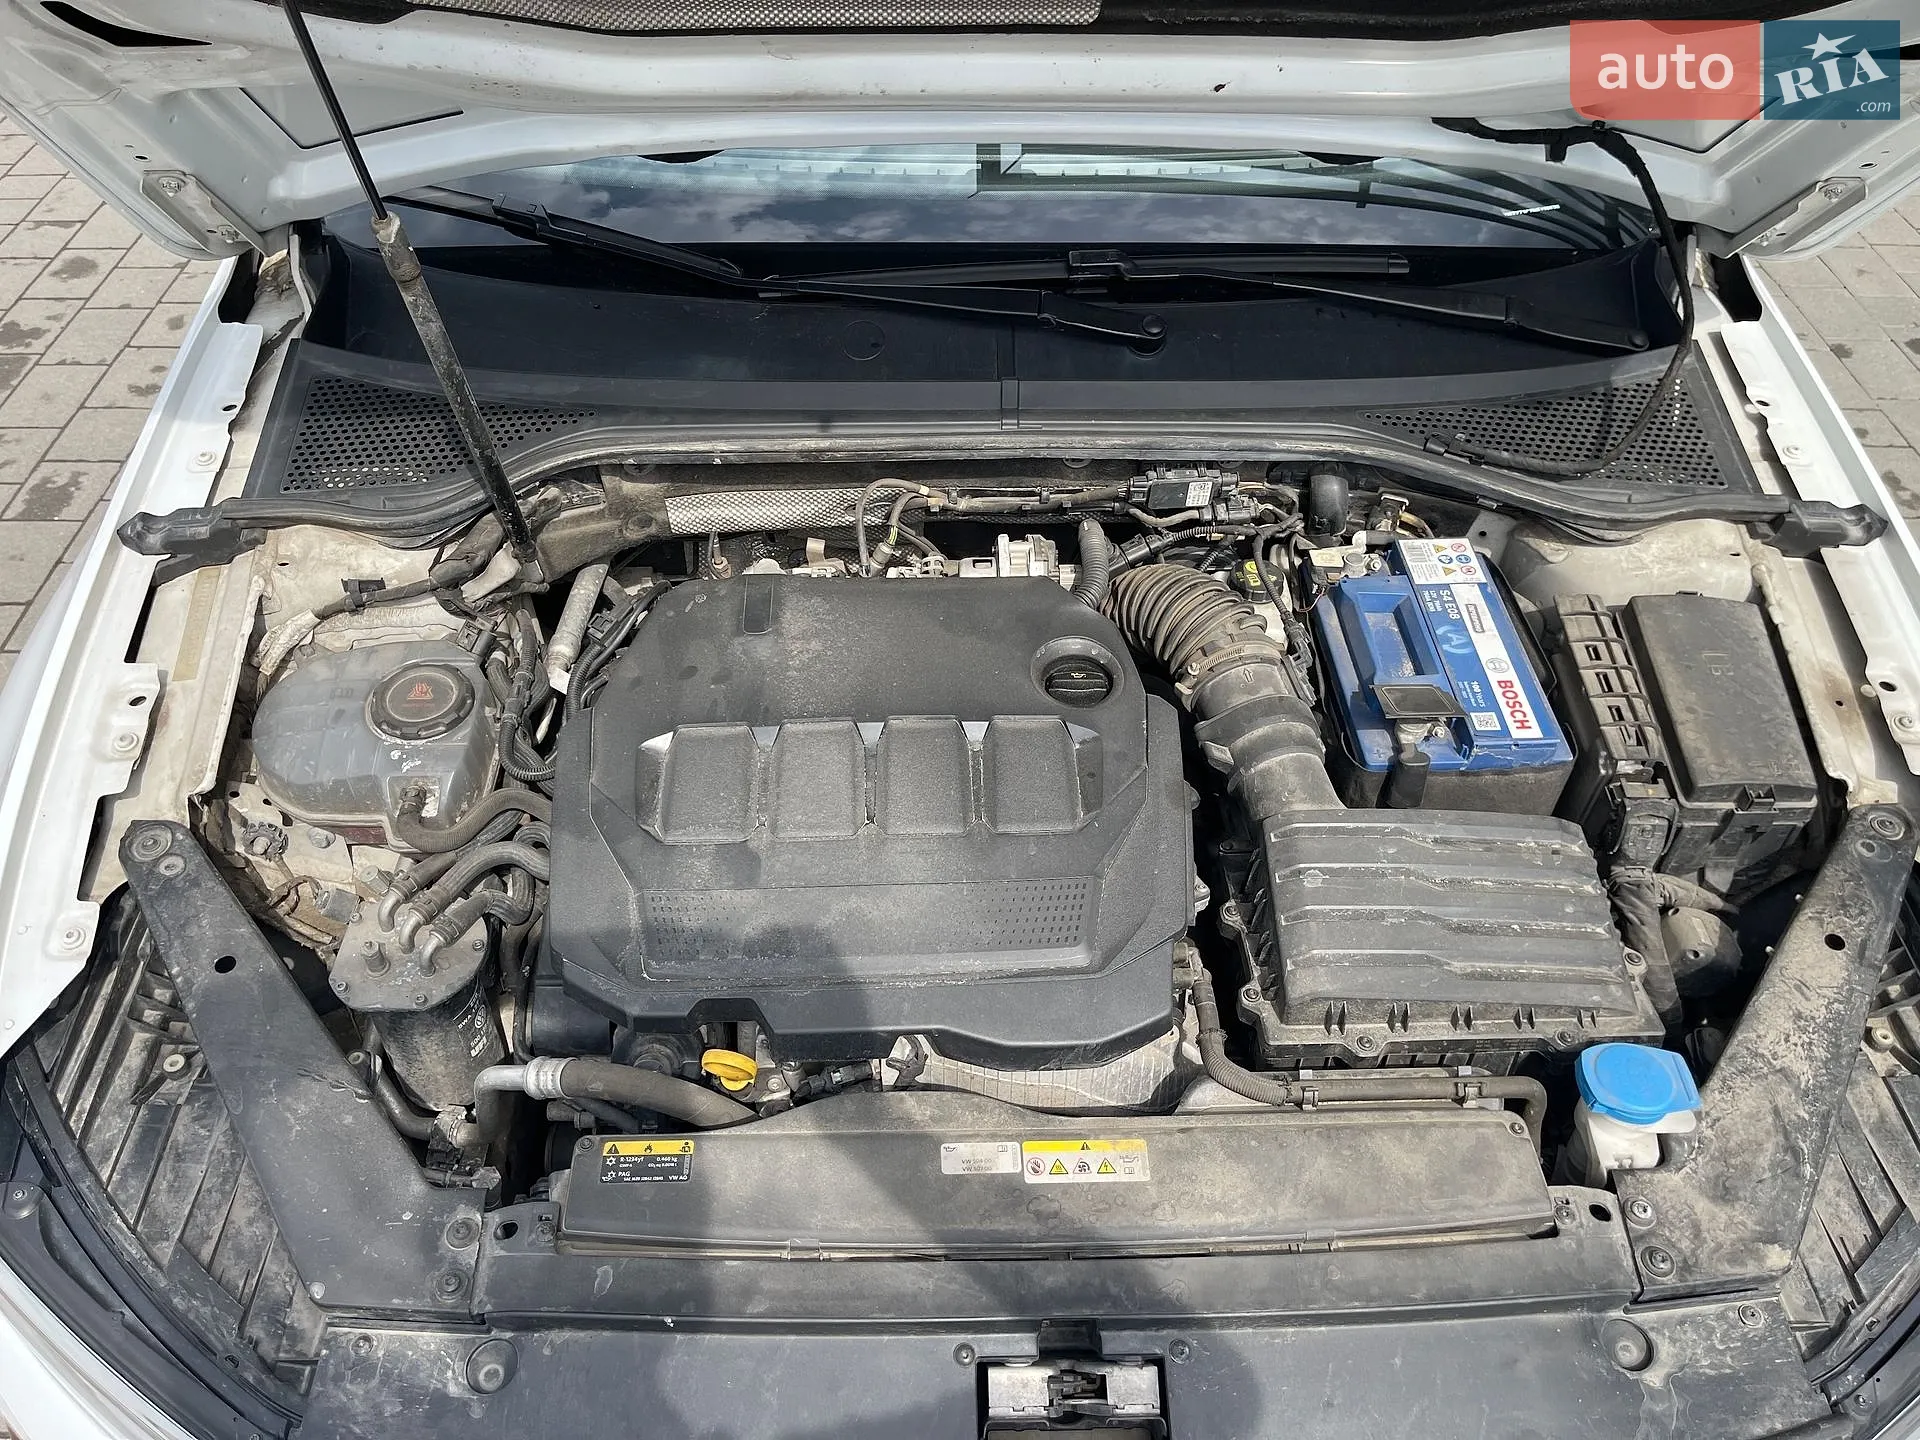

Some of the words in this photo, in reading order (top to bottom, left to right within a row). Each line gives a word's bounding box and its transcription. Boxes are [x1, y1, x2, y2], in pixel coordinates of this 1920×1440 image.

[1440, 590, 1454, 601] S4
[1445, 603, 1461, 619] E08
[1471, 681, 1482, 693] 100
[1497, 680, 1532, 729] BOSCH
